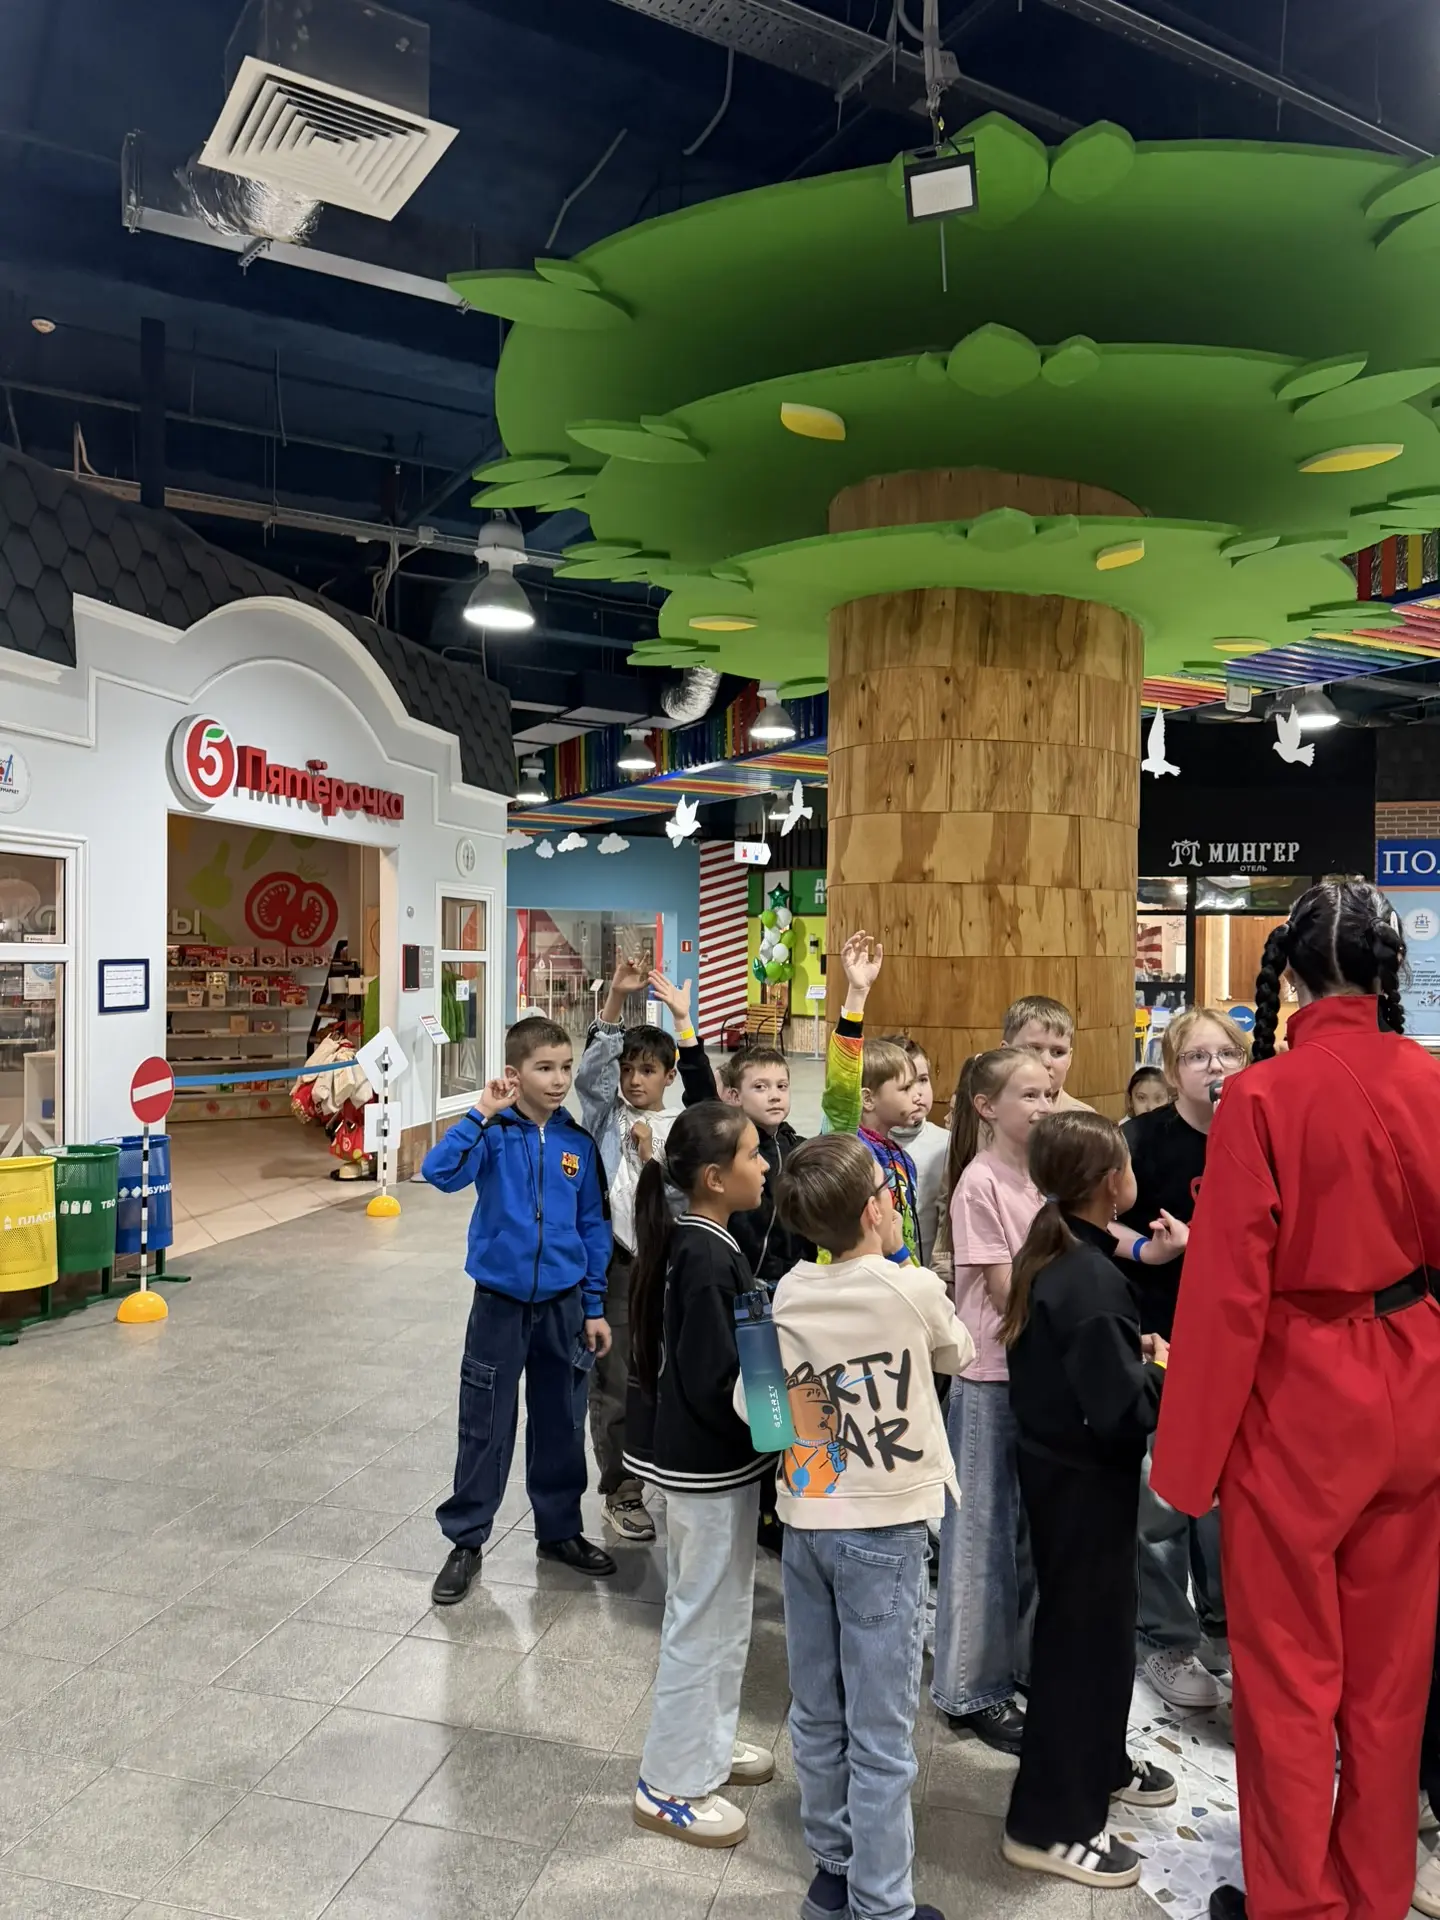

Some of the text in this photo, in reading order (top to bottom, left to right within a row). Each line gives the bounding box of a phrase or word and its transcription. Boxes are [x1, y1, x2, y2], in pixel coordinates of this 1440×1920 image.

[236, 745, 405, 820] Пятёрочка
[1208, 842, 1300, 863] МИНГЕР
[1239, 864, 1268, 872] ОТЕЛЬ
[1382, 850, 1440, 875] ПО
[147, 1182, 172, 1195] БУМА
[101, 1199, 116, 1209] ТБО
[18, 1211, 55, 1226] ПЛАСТ
[768, 1385, 781, 1428] SPIRIT
